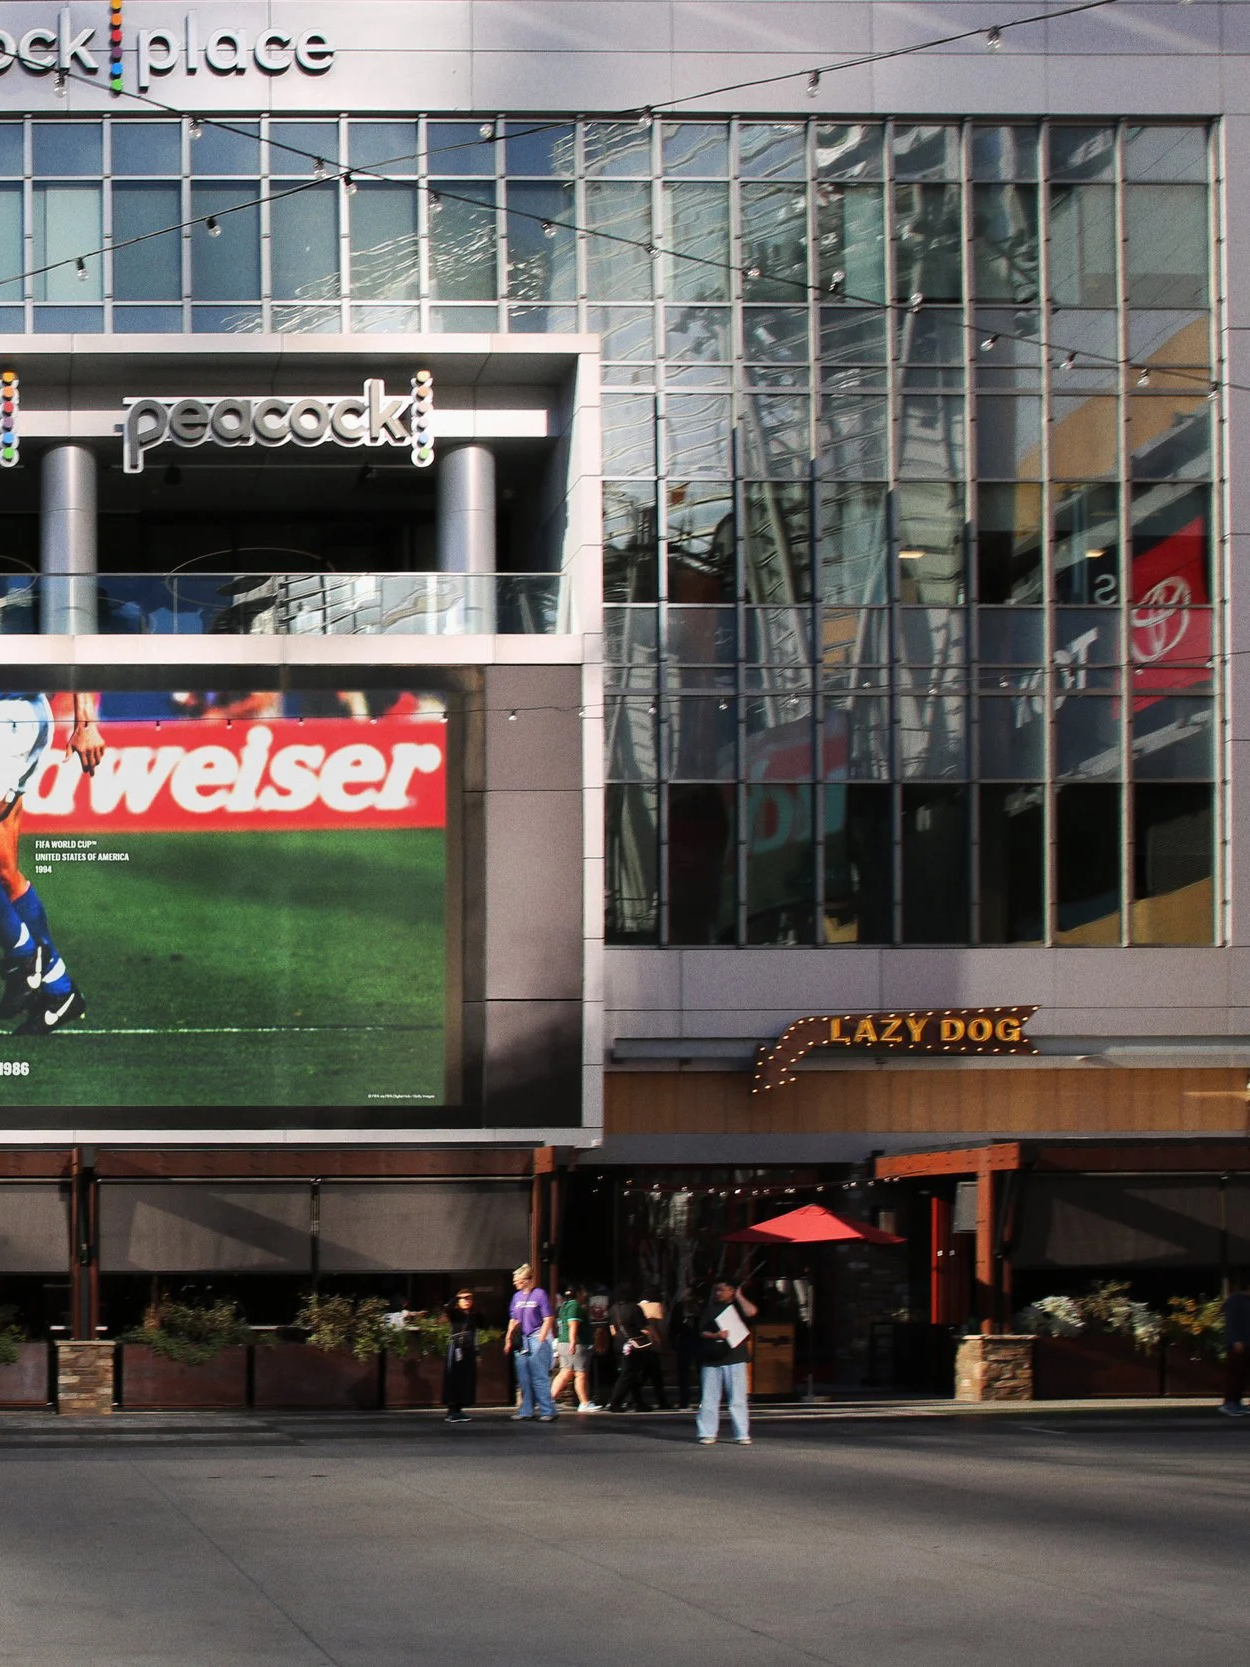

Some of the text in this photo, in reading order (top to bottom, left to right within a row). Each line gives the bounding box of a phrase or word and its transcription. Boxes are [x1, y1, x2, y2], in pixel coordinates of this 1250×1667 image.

[138, 9, 336, 93] place
[124, 379, 412, 473] peacock
[35, 840, 50, 849] FIFA
[51, 840, 76, 849] WORLD
[35, 853, 130, 861] UNITED STATES OF AMERICA
[35, 865, 52, 873] 1994
[829, 1017, 1022, 1043] LAZY DOG
